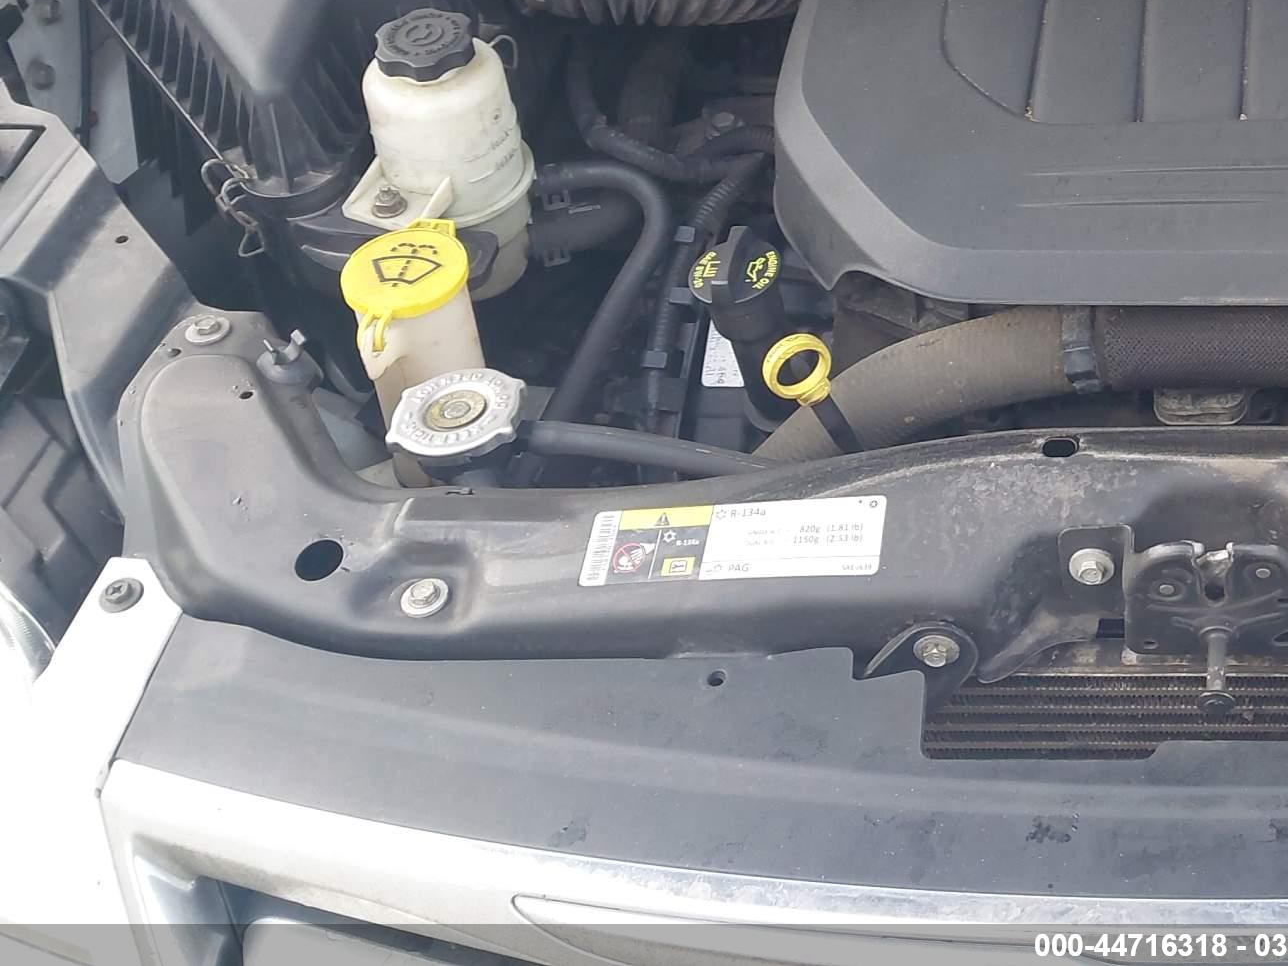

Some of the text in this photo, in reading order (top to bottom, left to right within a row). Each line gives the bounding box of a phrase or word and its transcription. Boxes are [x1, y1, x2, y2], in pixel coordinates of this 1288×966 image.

[751, 250, 778, 290] ENGINE OIL
[728, 563, 750, 572] PAG
